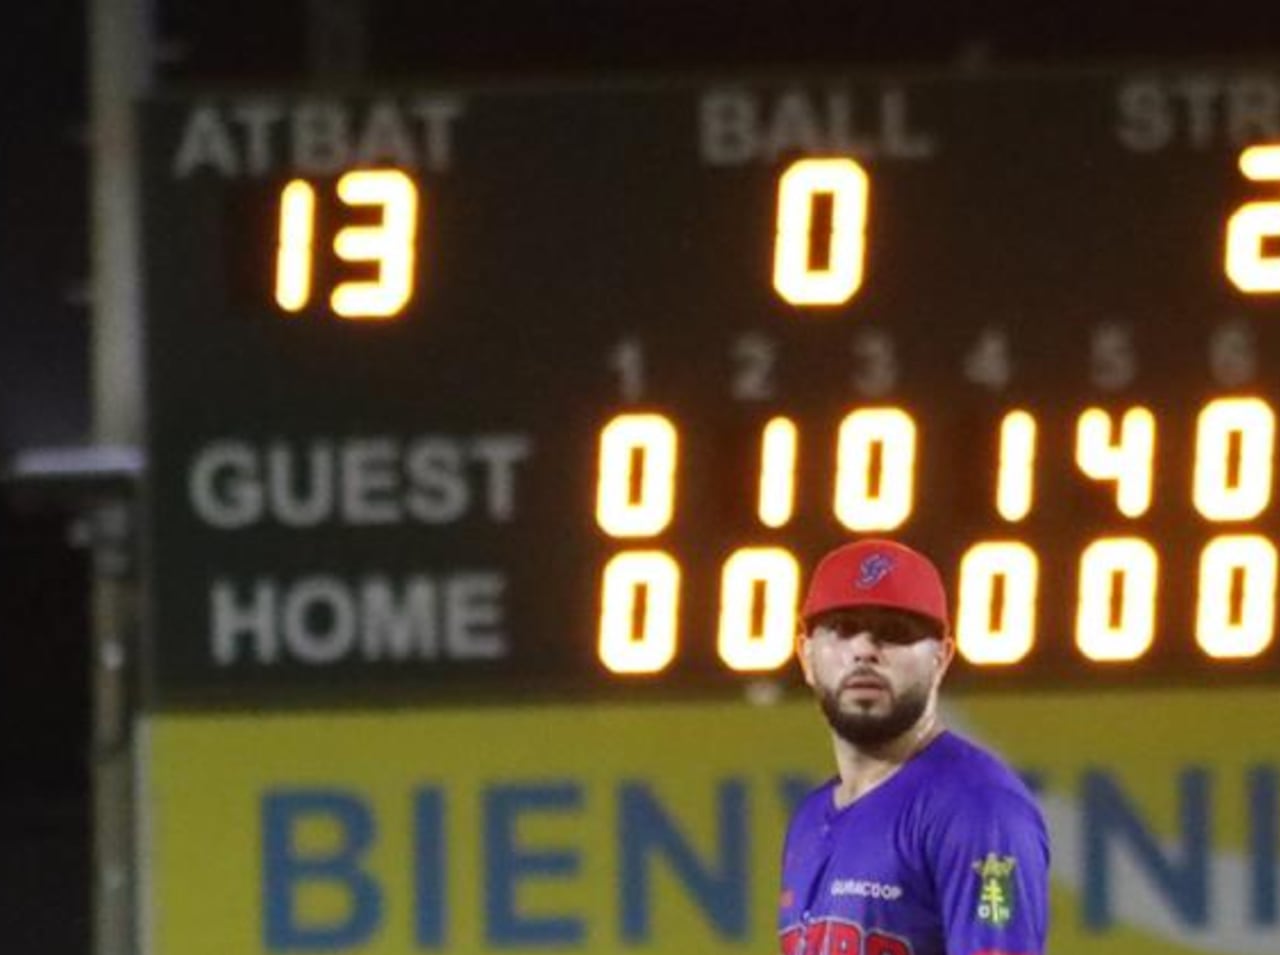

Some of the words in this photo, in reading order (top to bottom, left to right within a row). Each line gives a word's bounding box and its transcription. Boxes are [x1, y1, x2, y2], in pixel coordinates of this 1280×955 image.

[698, 88, 935, 166] BALL
[274, 169, 419, 318] 13
[772, 157, 869, 306] 0
[610, 336, 647, 400] 1
[730, 333, 778, 398] 2
[852, 330, 898, 397] 3
[964, 326, 1011, 391] 4
[1090, 321, 1138, 389] 5
[1208, 318, 1256, 386] 6
[189, 437, 531, 528] GUEST
[595, 413, 678, 539] 0
[757, 416, 798, 529] 1
[833, 407, 918, 533] 0
[995, 410, 1037, 523] 1
[1075, 406, 1157, 519] 4
[1192, 396, 1277, 523] 0
[211, 573, 508, 667] HOME
[597, 549, 682, 675] 0
[716, 546, 800, 672] 0
[954, 540, 1040, 666] 0
[1074, 536, 1159, 662] 0
[1194, 533, 1279, 659] 0
